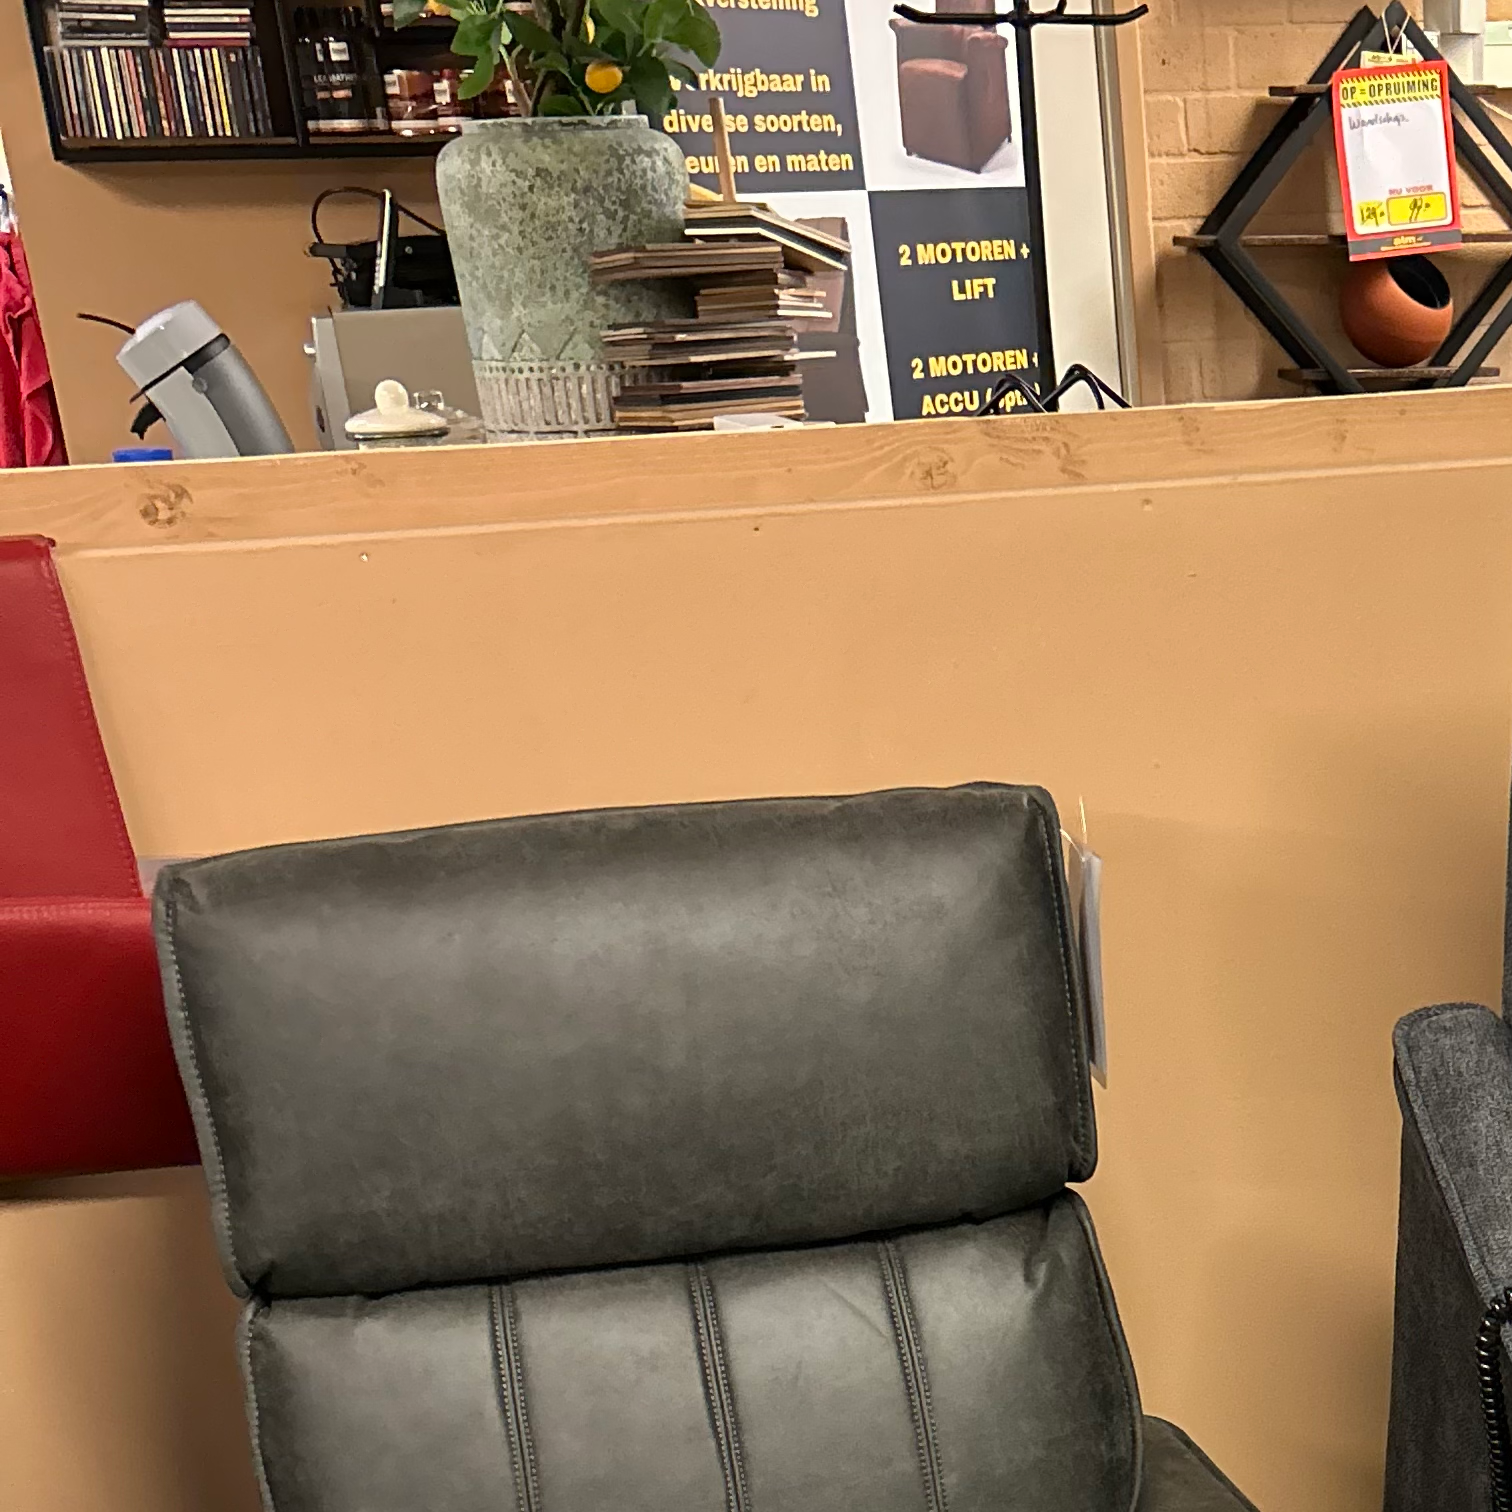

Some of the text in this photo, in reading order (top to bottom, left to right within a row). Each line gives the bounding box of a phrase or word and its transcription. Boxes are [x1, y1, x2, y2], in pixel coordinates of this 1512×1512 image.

[809, 68, 831, 92] in
[1341, 86, 1357, 101] OP
[1368, 77, 1438, 101] OPRUIMING
[663, 109, 843, 137] divese soorten,
[754, 155, 781, 173] en
[786, 150, 854, 172] maten
[898, 240, 1031, 266] 2 MOTOREN +
[951, 277, 997, 301] LIFT
[911, 357, 925, 380] 2
[928, 349, 1029, 378] MOTOREN
[921, 389, 980, 416] ACCU
